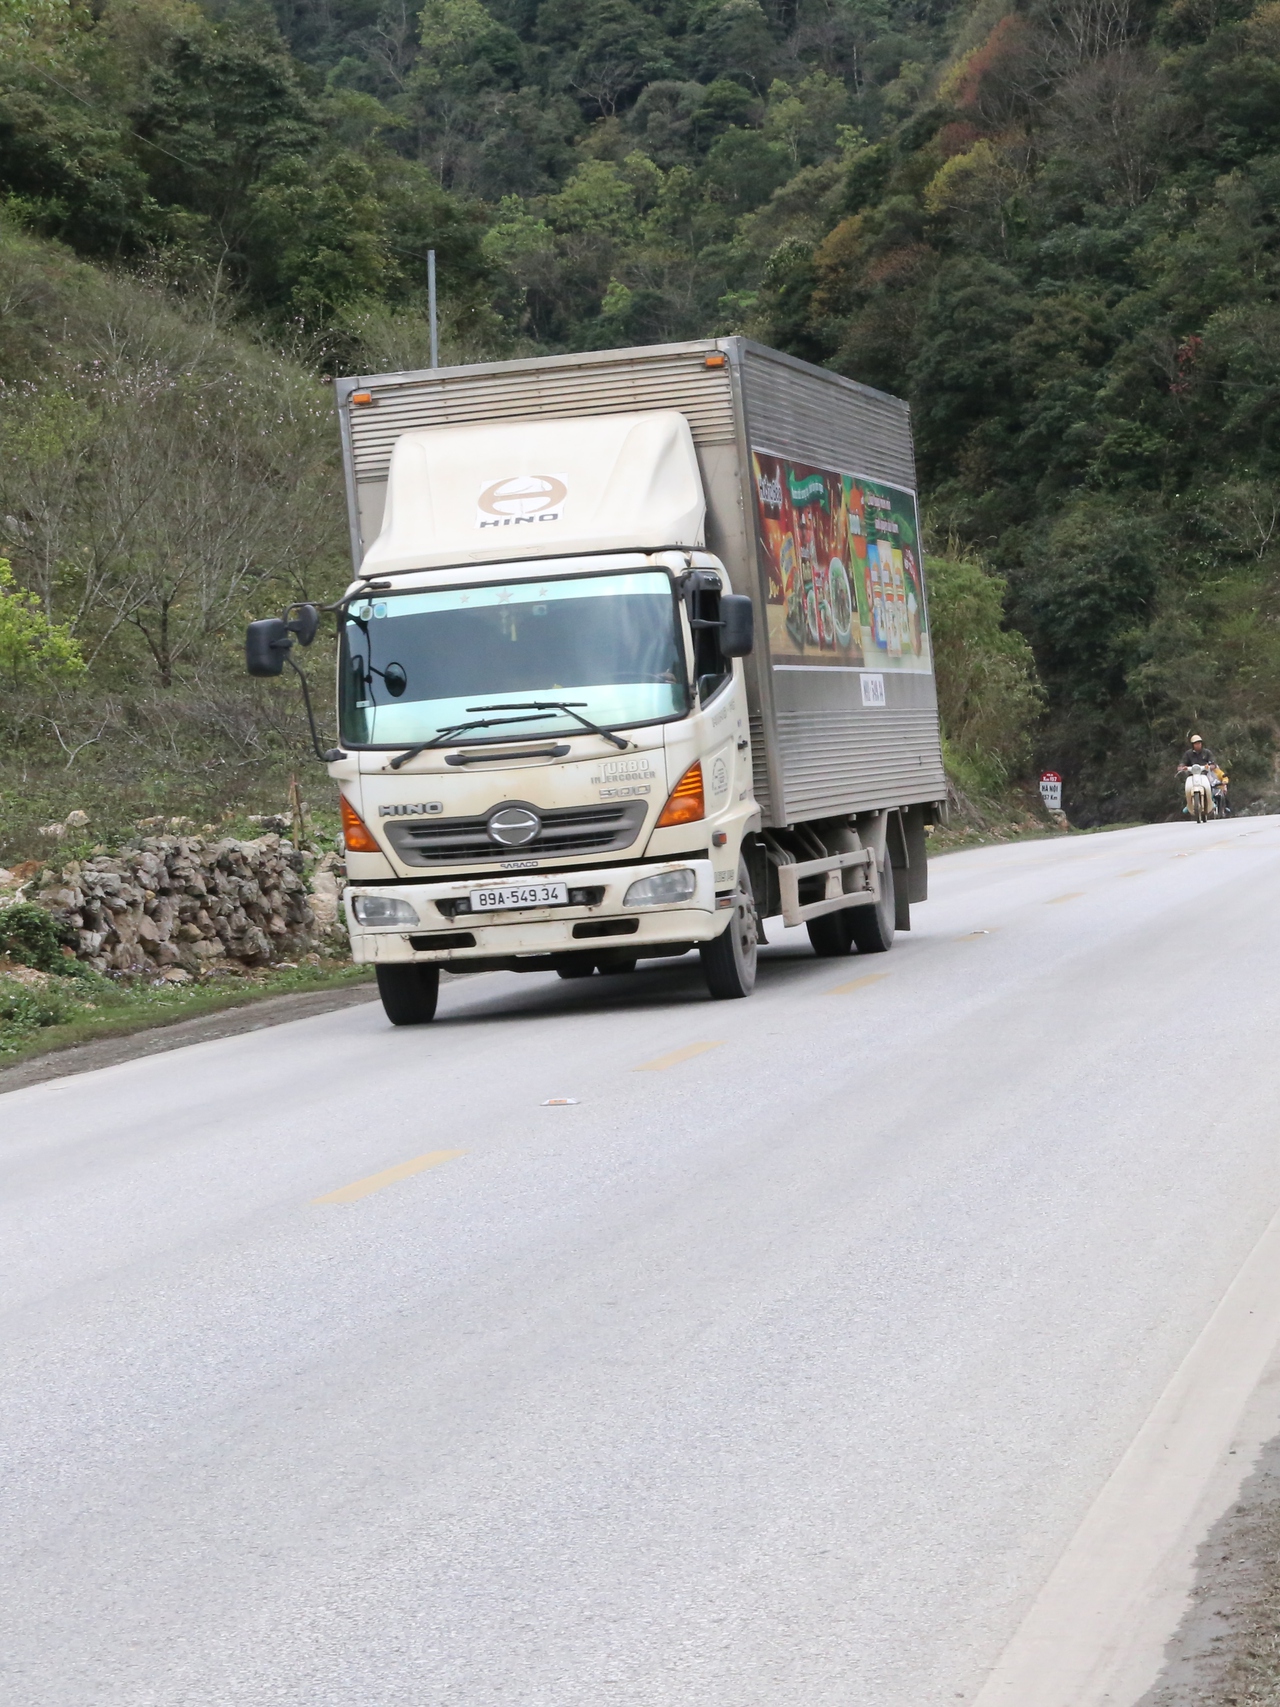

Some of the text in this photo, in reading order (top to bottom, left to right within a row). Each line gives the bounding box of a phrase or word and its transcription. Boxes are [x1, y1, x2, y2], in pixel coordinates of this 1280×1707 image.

[480, 513, 558, 528] HINO
[590, 770, 656, 785] INTERCOOLER
[598, 758, 649, 781] TURBO
[599, 783, 651, 799] 500
[378, 801, 443, 817] HINO
[479, 887, 559, 906] 89A-549.34
